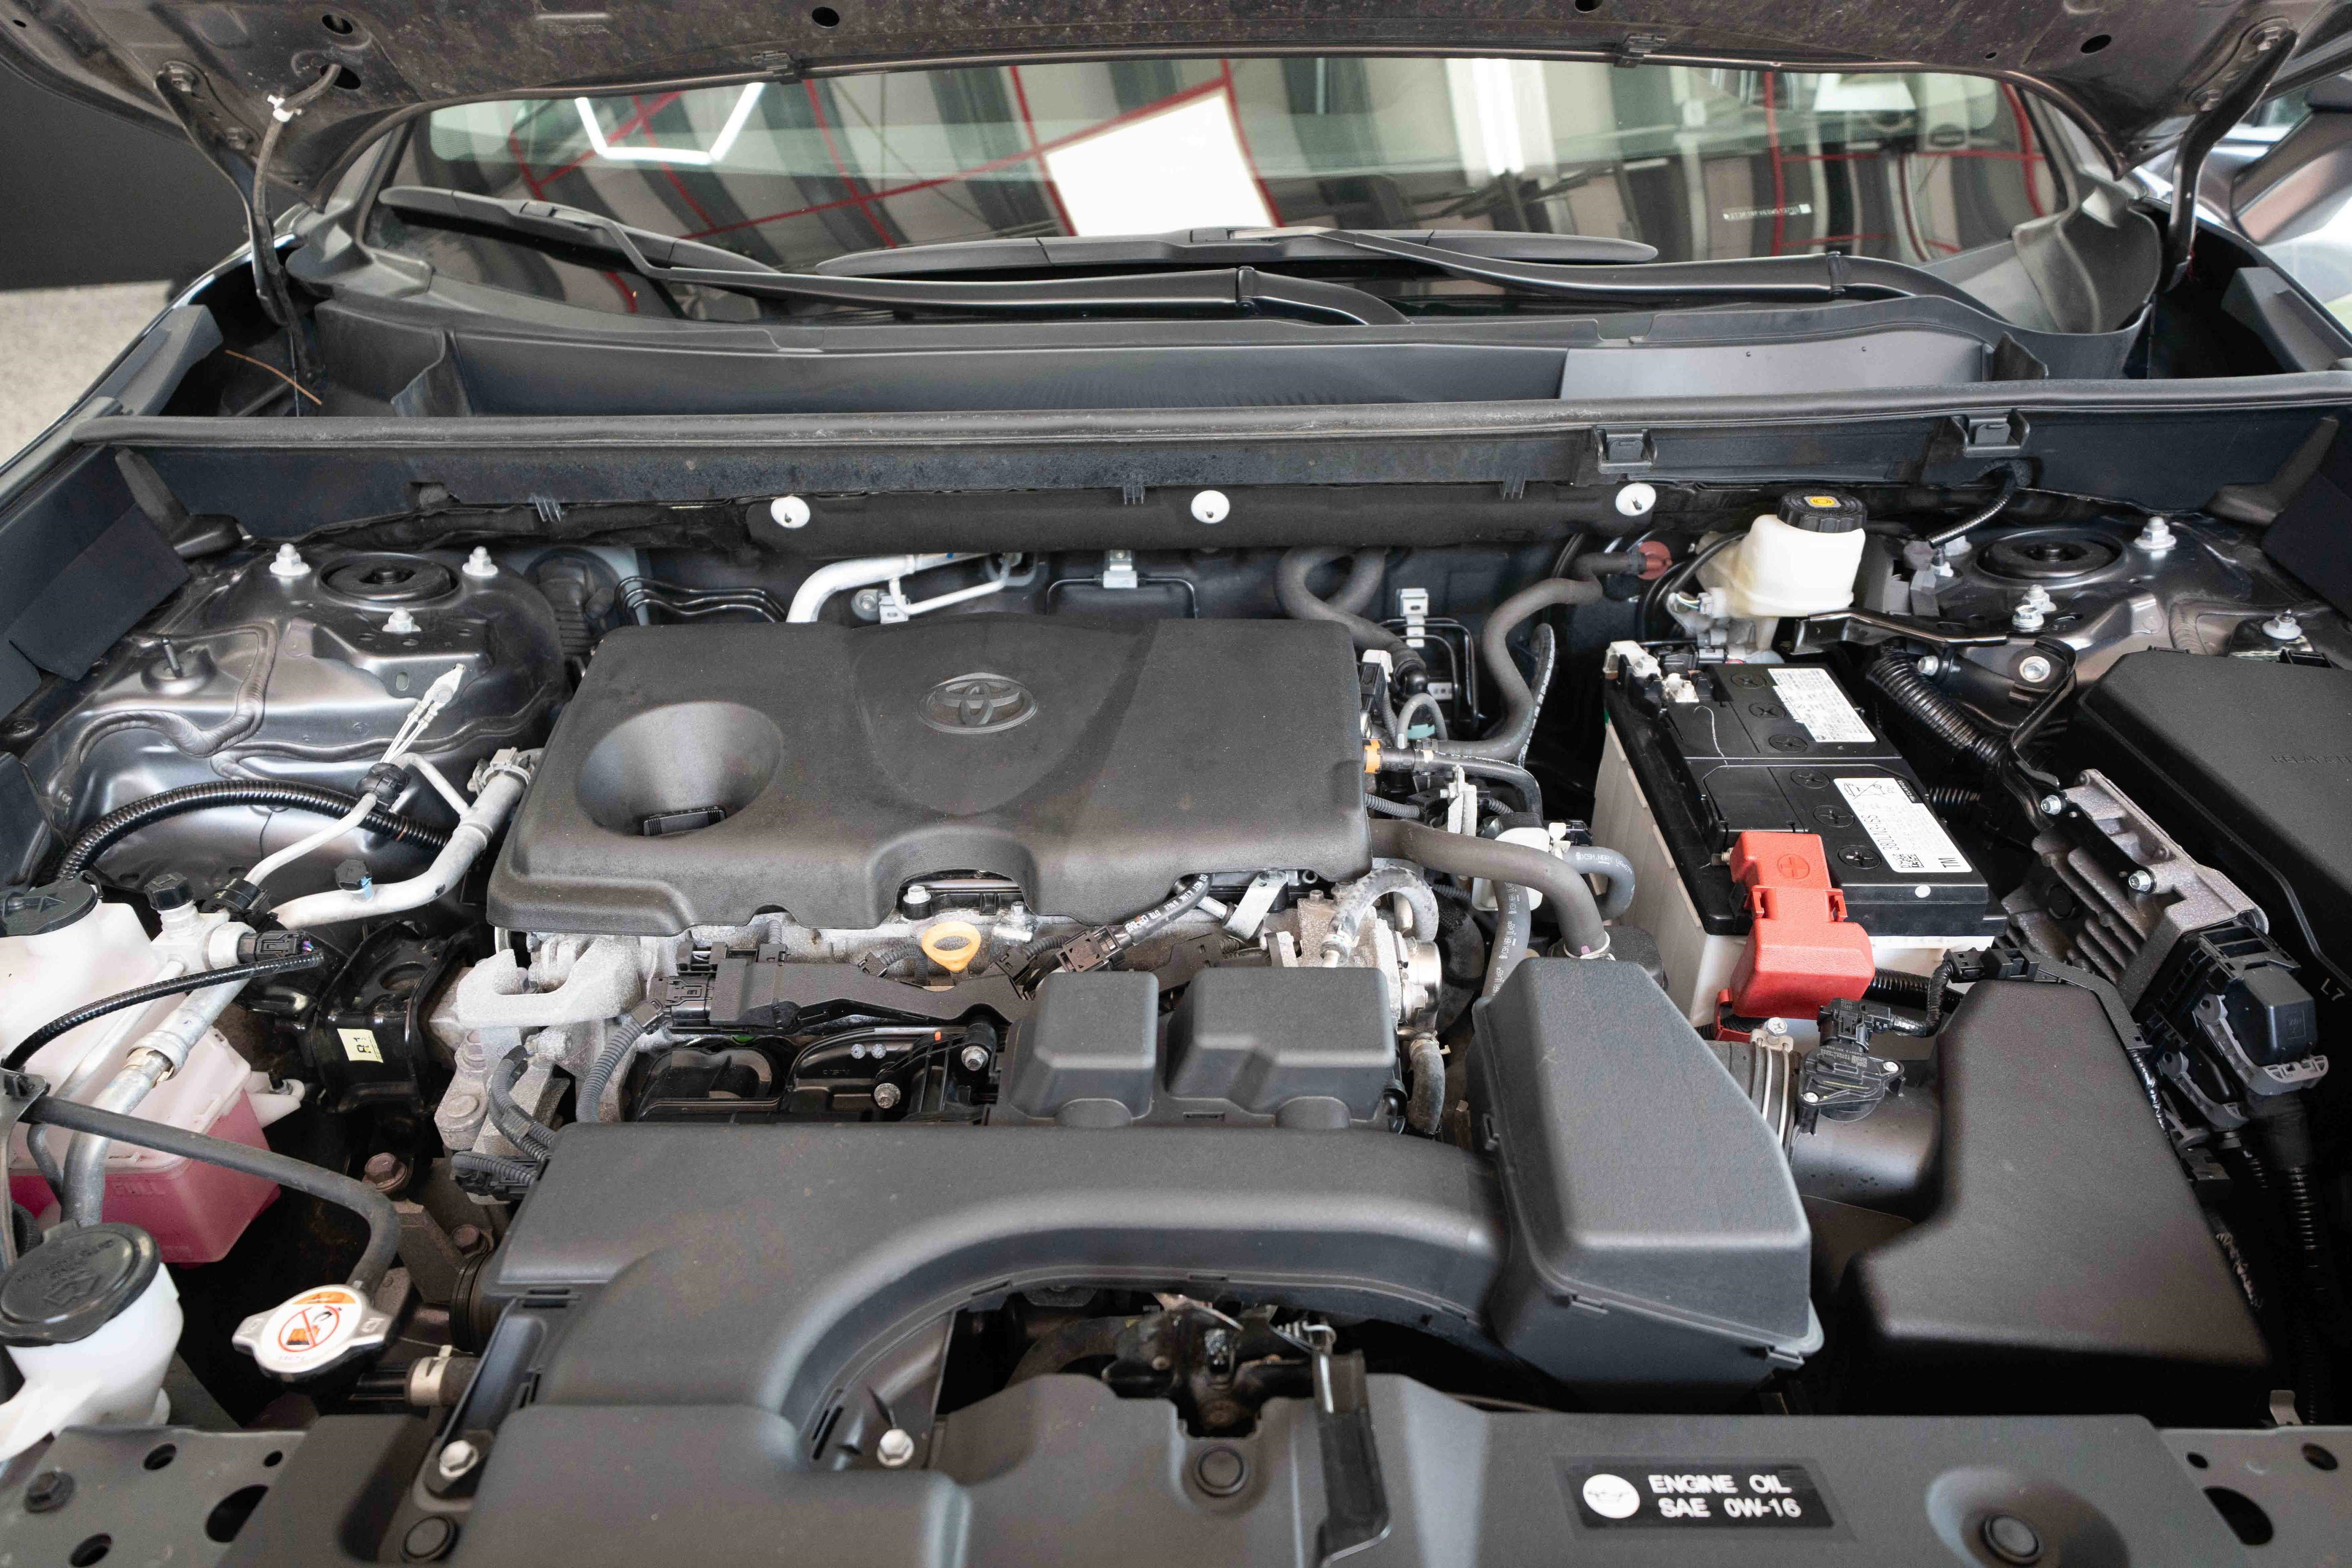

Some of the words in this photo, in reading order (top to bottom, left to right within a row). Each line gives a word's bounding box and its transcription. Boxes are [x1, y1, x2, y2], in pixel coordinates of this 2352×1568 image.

[1898, 780, 1912, 800] CLARIOS
[1938, 858, 1961, 868] TM
[1648, 1474, 1739, 1494] ENGINE
[1749, 1474, 1793, 1494] OIL
[1658, 1498, 1711, 1518] SAE
[1724, 1498, 1802, 1518] 0W-16
